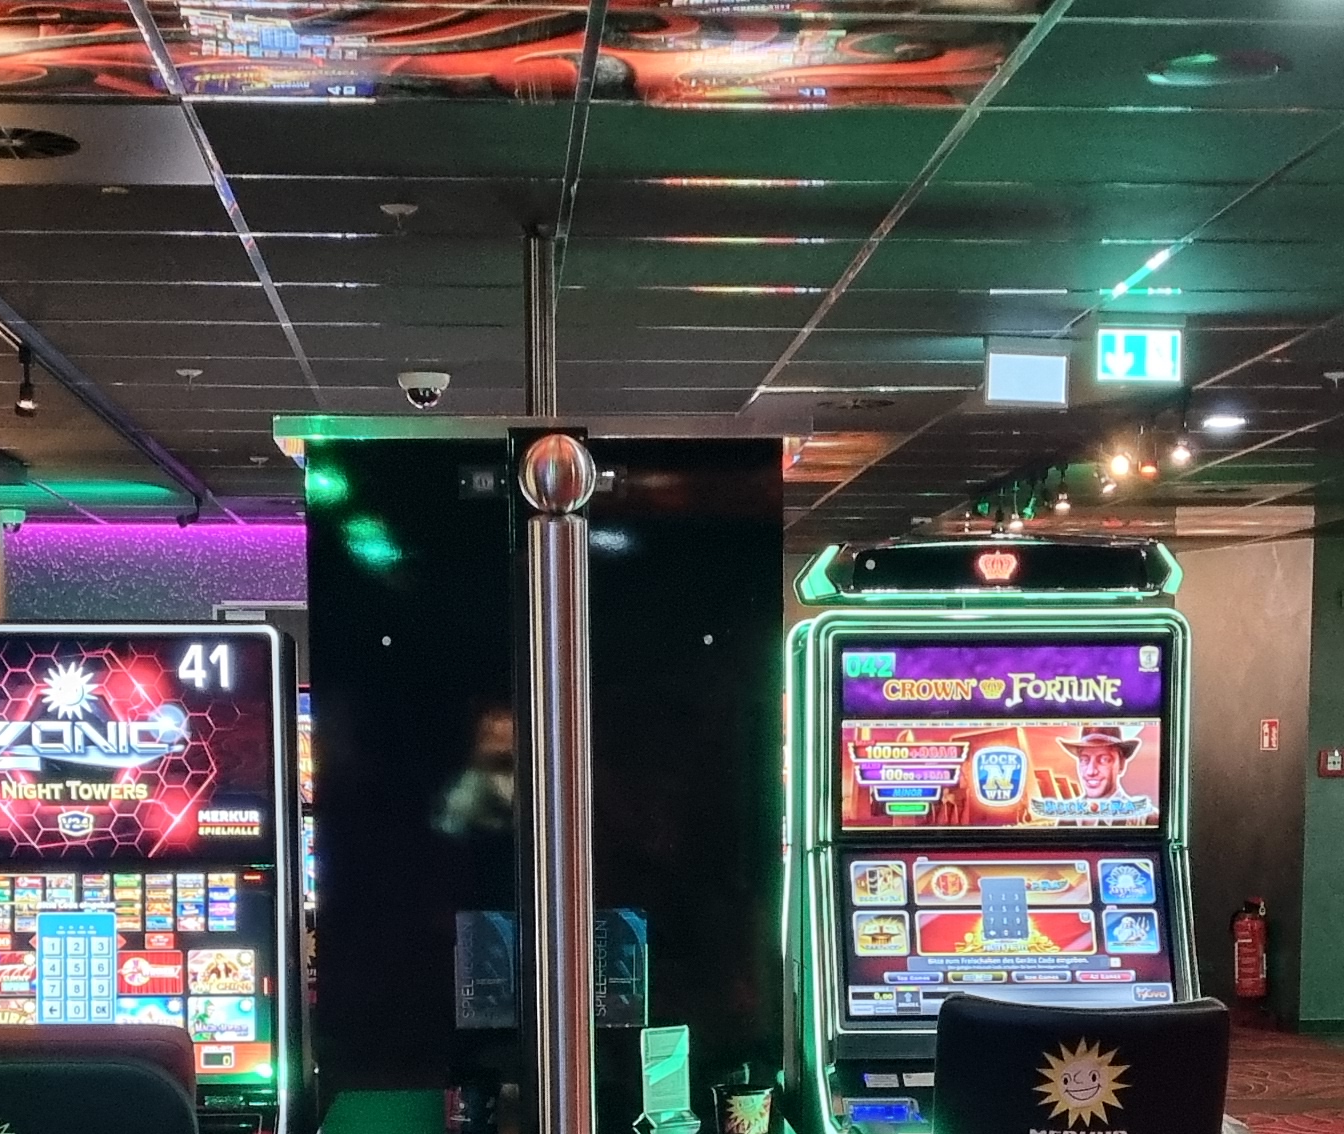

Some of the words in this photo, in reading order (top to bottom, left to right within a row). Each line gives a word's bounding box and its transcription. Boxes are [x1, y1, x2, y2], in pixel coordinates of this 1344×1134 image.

[178, 644, 232, 689] 41
[846, 655, 893, 678] 042
[883, 679, 972, 700] CROWN
[1006, 672, 1123, 707] FORTUNE
[981, 754, 1019, 764] LOCK
[1, 780, 63, 799] NIGHT
[66, 780, 148, 800] TOWERS
[985, 789, 1012, 799] WIN
[198, 810, 260, 822] MERKUR
[198, 826, 260, 836] SPIELHALLE
[73, 942, 80, 951] 2
[97, 942, 104, 951] 3
[49, 963, 56, 972] 4
[73, 963, 80, 972] 5
[97, 963, 105, 972] 6
[49, 984, 56, 993] 7
[73, 984, 80, 993] 8
[97, 984, 105, 993] 9
[73, 1005, 80, 1015] 0
[95, 1005, 107, 1014] OK
